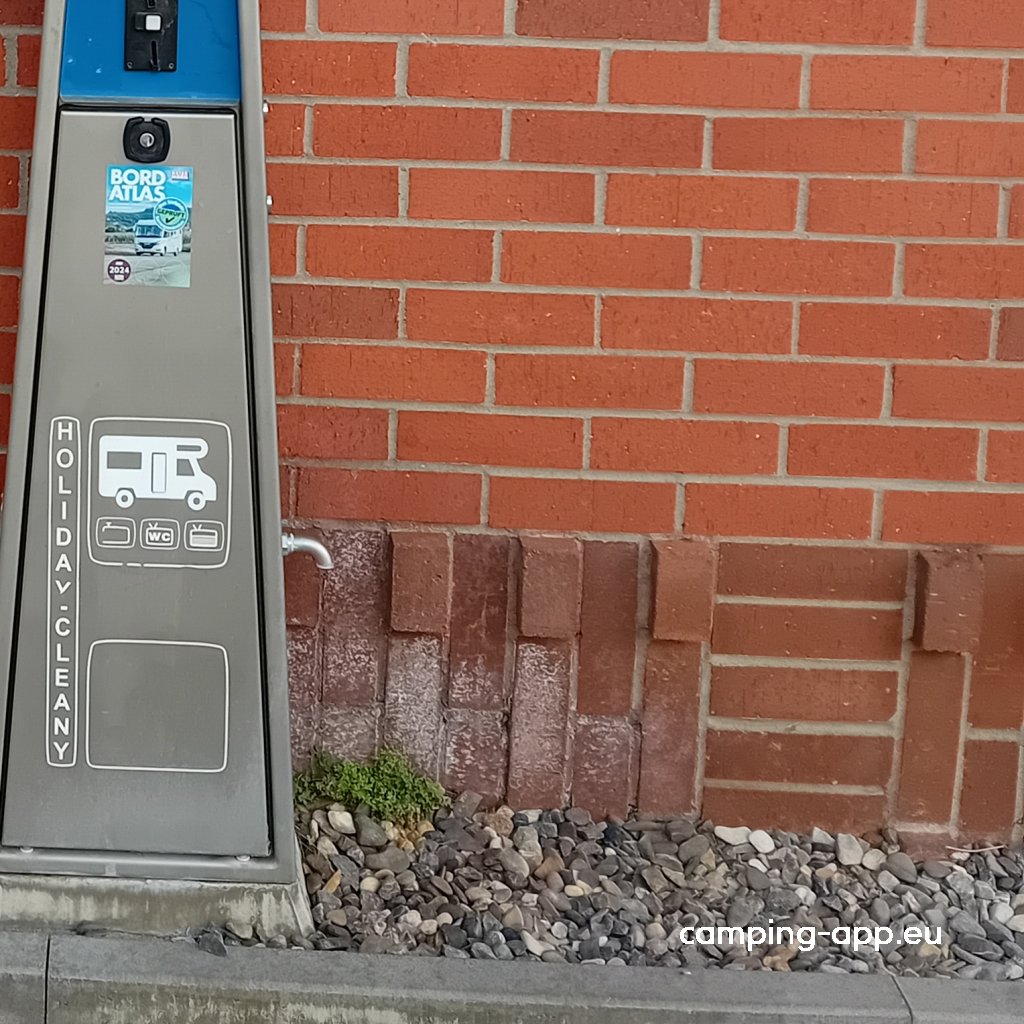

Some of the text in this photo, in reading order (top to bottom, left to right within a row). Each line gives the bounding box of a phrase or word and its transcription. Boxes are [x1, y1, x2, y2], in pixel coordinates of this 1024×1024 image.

[110, 169, 166, 186] BORD
[109, 186, 165, 202] ATLAS
[109, 266, 130, 275] 2024
[148, 531, 172, 543] WC
